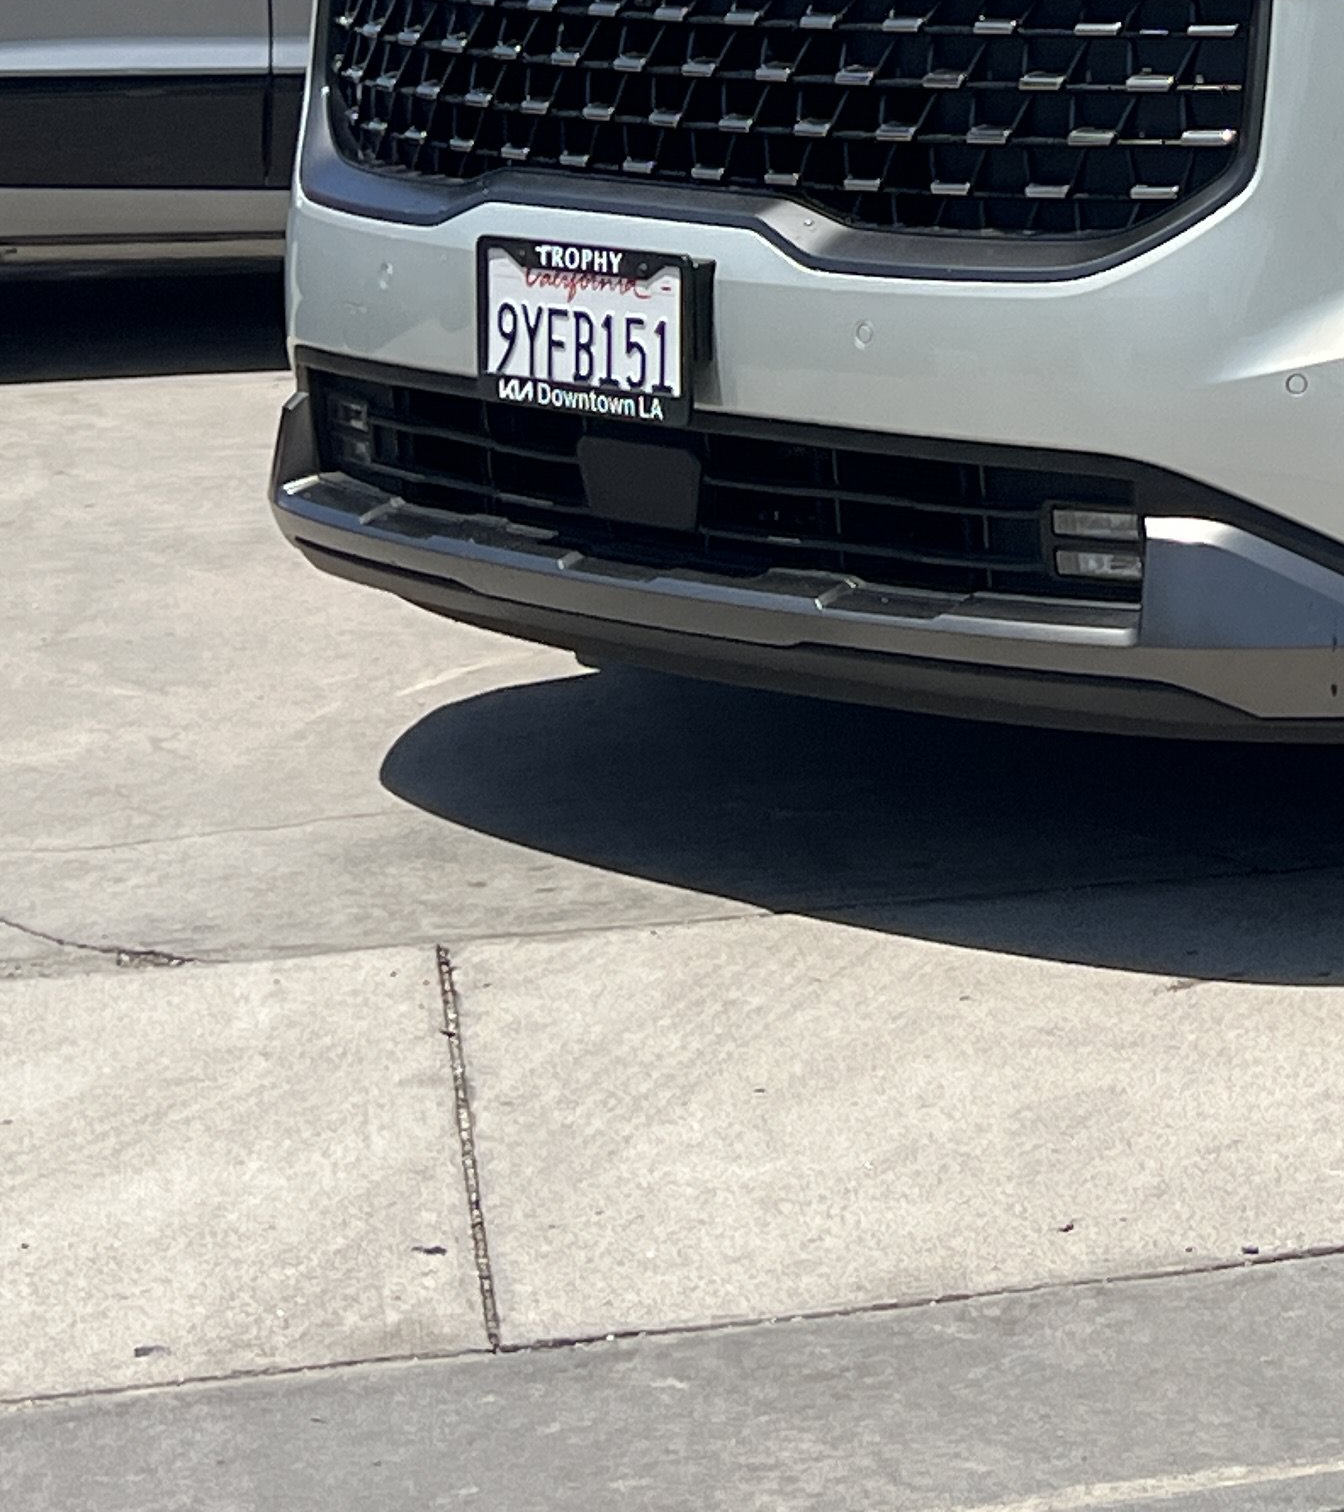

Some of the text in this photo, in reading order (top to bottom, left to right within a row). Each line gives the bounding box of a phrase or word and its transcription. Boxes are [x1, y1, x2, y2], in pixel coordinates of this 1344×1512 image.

[535, 245, 623, 273] TROPHY
[498, 303, 672, 393] 9YFB151
[499, 378, 664, 421] KIA Downtown LA
